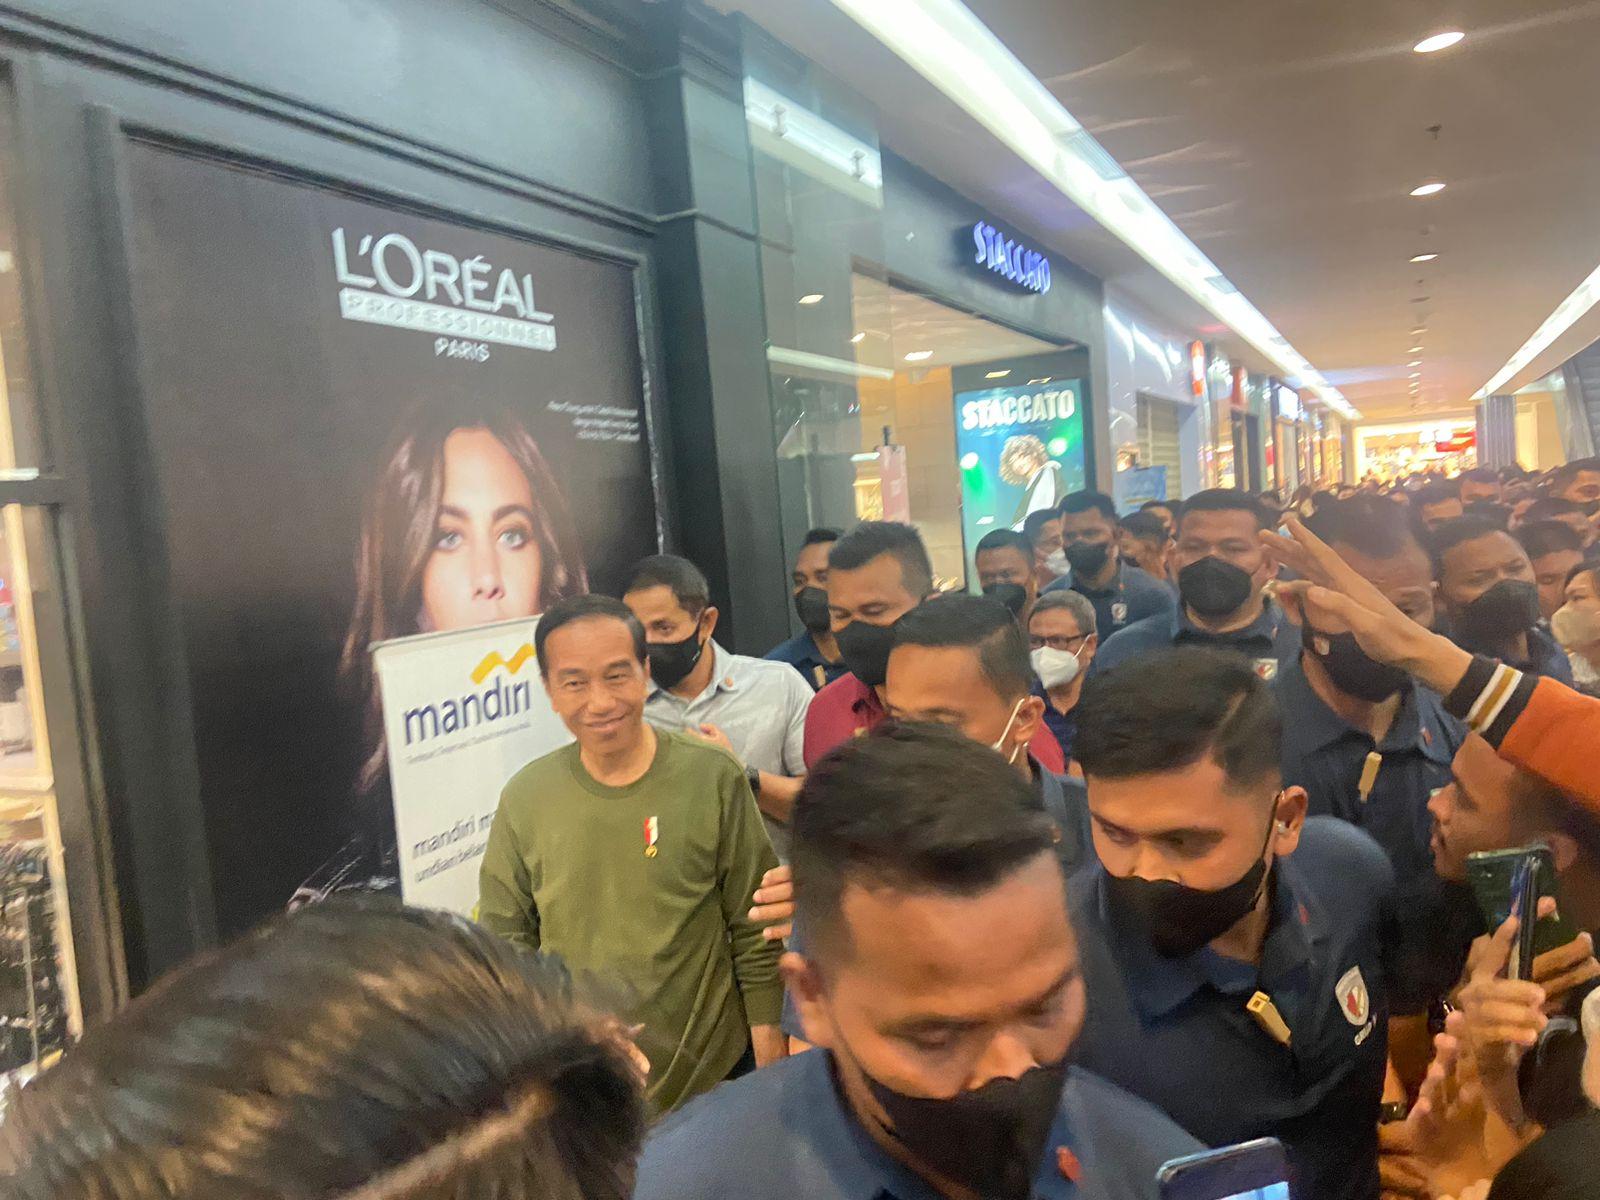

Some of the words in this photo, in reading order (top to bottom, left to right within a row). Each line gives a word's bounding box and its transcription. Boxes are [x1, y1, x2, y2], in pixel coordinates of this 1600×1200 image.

[332, 227, 555, 323] L'ORÉAL
[973, 219, 1052, 297] STACCATO
[434, 336, 490, 363] PARIS
[961, 388, 1076, 431] STACCATO
[403, 674, 531, 746] mandiri
[412, 814, 475, 860] mandiri
